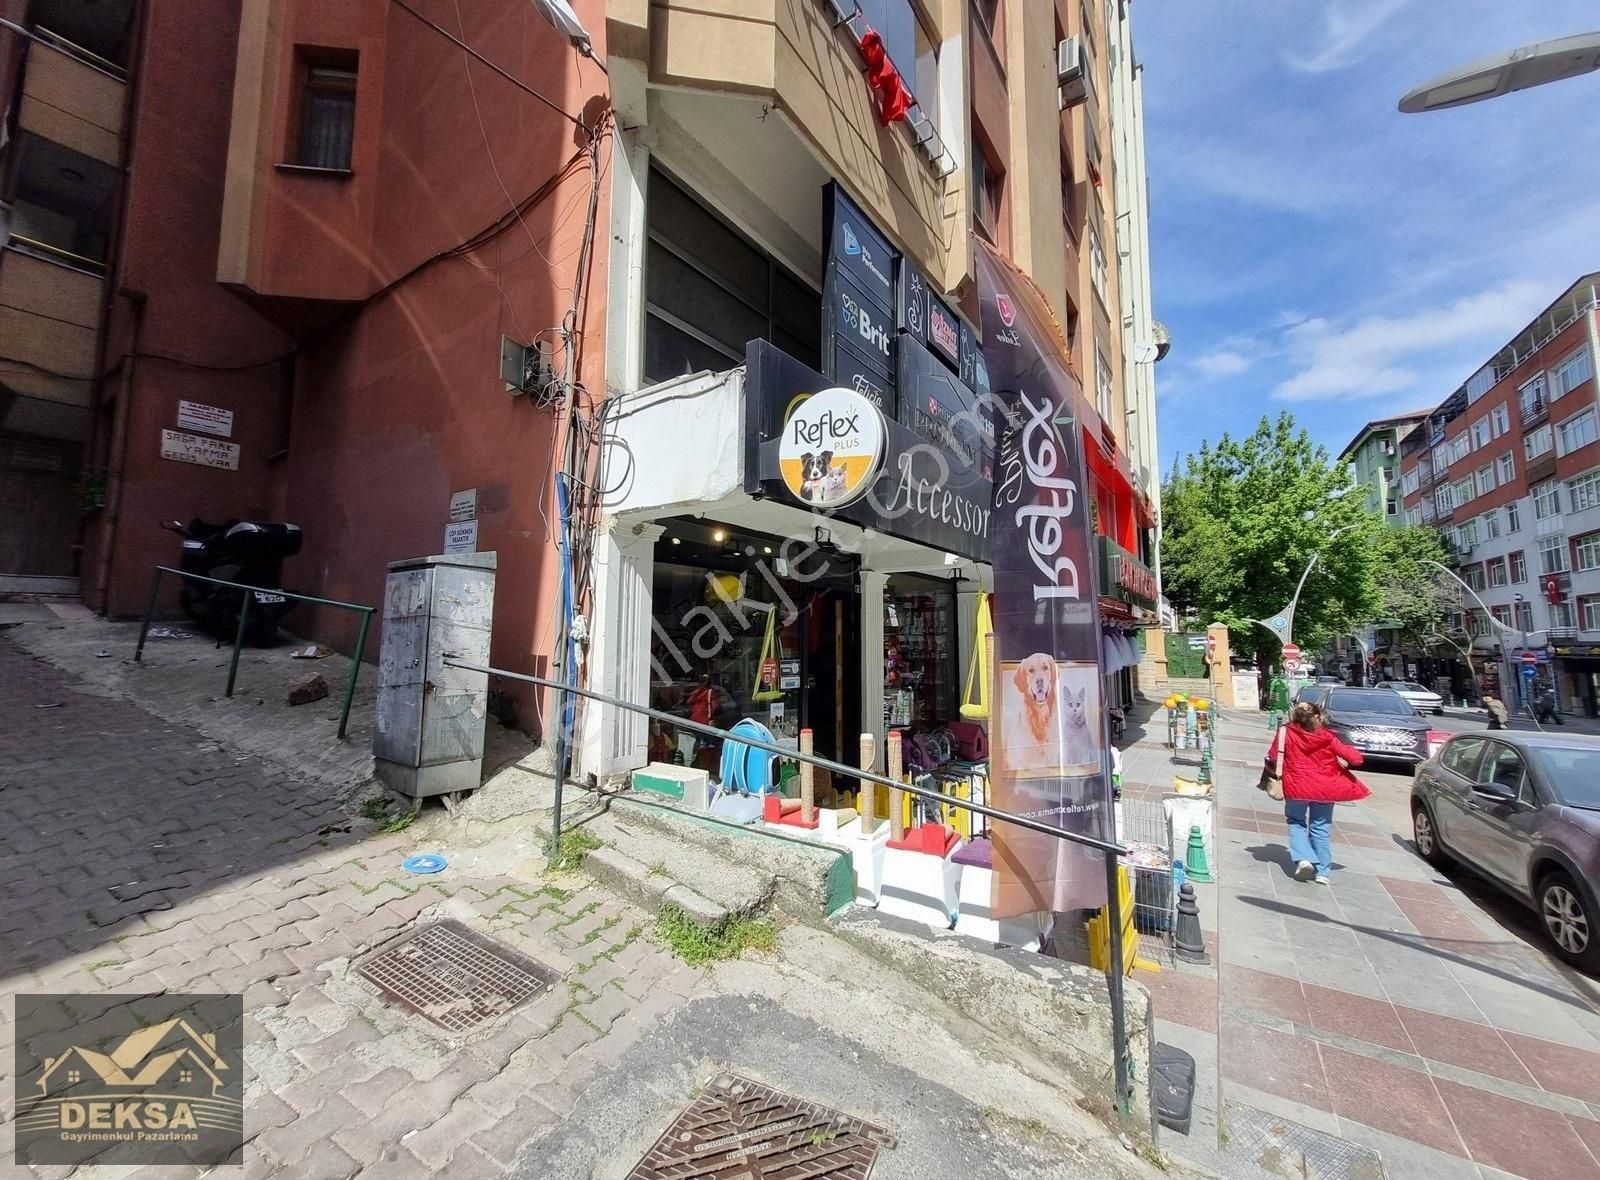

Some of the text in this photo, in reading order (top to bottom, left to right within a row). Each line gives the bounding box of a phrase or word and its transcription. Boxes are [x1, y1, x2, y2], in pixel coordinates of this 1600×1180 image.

[859, 305, 891, 356] Brit
[852, 374, 883, 407] Felicia
[794, 410, 859, 449] Reflex
[834, 438, 860, 450] PLUS
[886, 452, 991, 538] Accessor
[428, 966, 468, 991] TELEKOM
[445, 964, 467, 981] TÜRK
